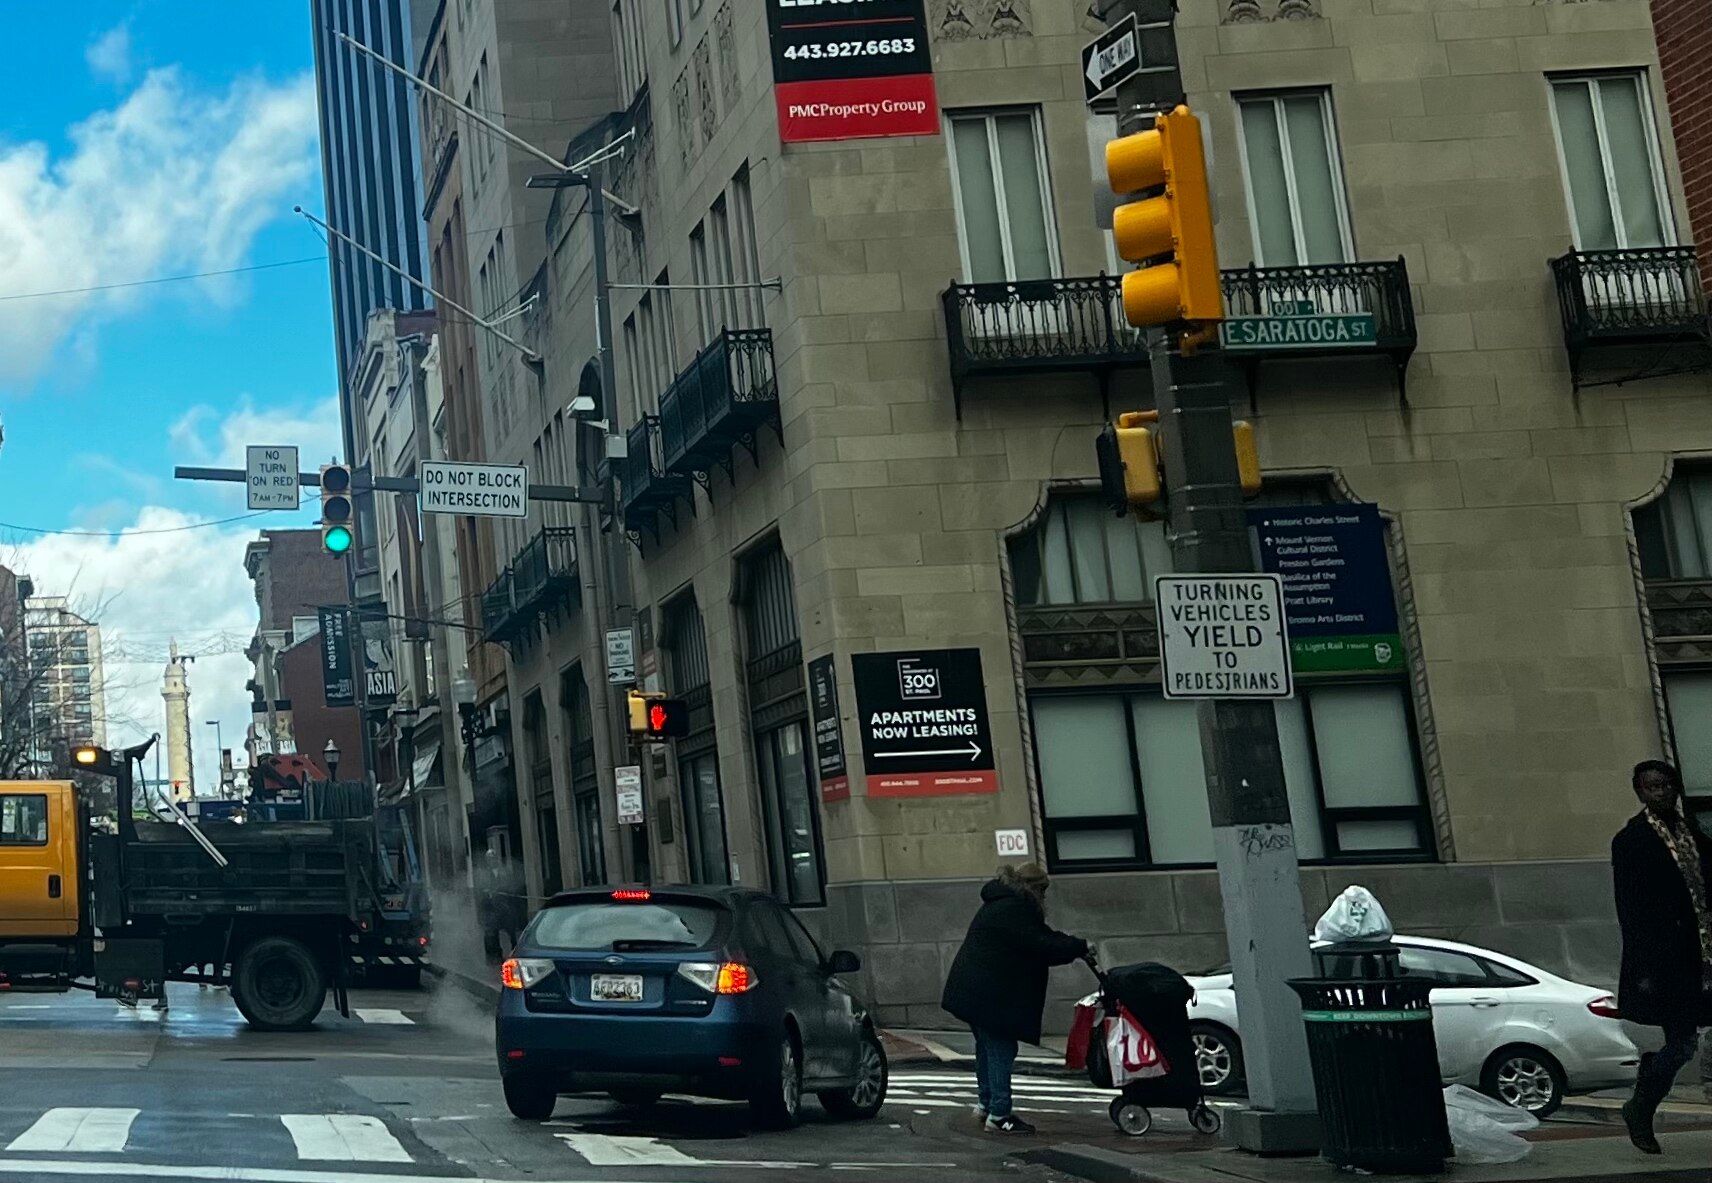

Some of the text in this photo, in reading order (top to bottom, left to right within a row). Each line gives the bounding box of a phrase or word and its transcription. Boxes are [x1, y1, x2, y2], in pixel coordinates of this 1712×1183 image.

[783, 38, 916, 60] 443.927.6683
[1099, 36, 1132, 74] ONE WAY
[881, 98, 926, 114] Group
[1225, 318, 1367, 343] E SARATOGA ST
[265, 450, 280, 460] NO
[259, 463, 287, 473] TURN
[252, 476, 294, 486] ON RED
[426, 470, 521, 488] DO NOT BLOCK
[428, 491, 520, 508] INTERSECTION
[1304, 517, 1334, 525] Charles
[1335, 516, 1360, 524] Street
[1275, 536, 1303, 545] Mount
[1276, 544, 1338, 555] Cultural District
[1322, 572, 1336, 580] the
[1173, 583, 1263, 601] TURNING
[1171, 604, 1271, 621] VEHICLES
[1335, 614, 1364, 622] District
[325, 614, 336, 669] ADMISSION
[1183, 625, 1262, 647] YIELD
[1212, 651, 1237, 668] TO
[368, 671, 396, 695] ASIA
[902, 674, 936, 688] 300
[1175, 672, 1279, 691] PEDESTRIANS
[870, 708, 977, 725] APARTMENTS
[872, 723, 978, 739] NOW LEASING!
[999, 833, 1025, 852] FDC
